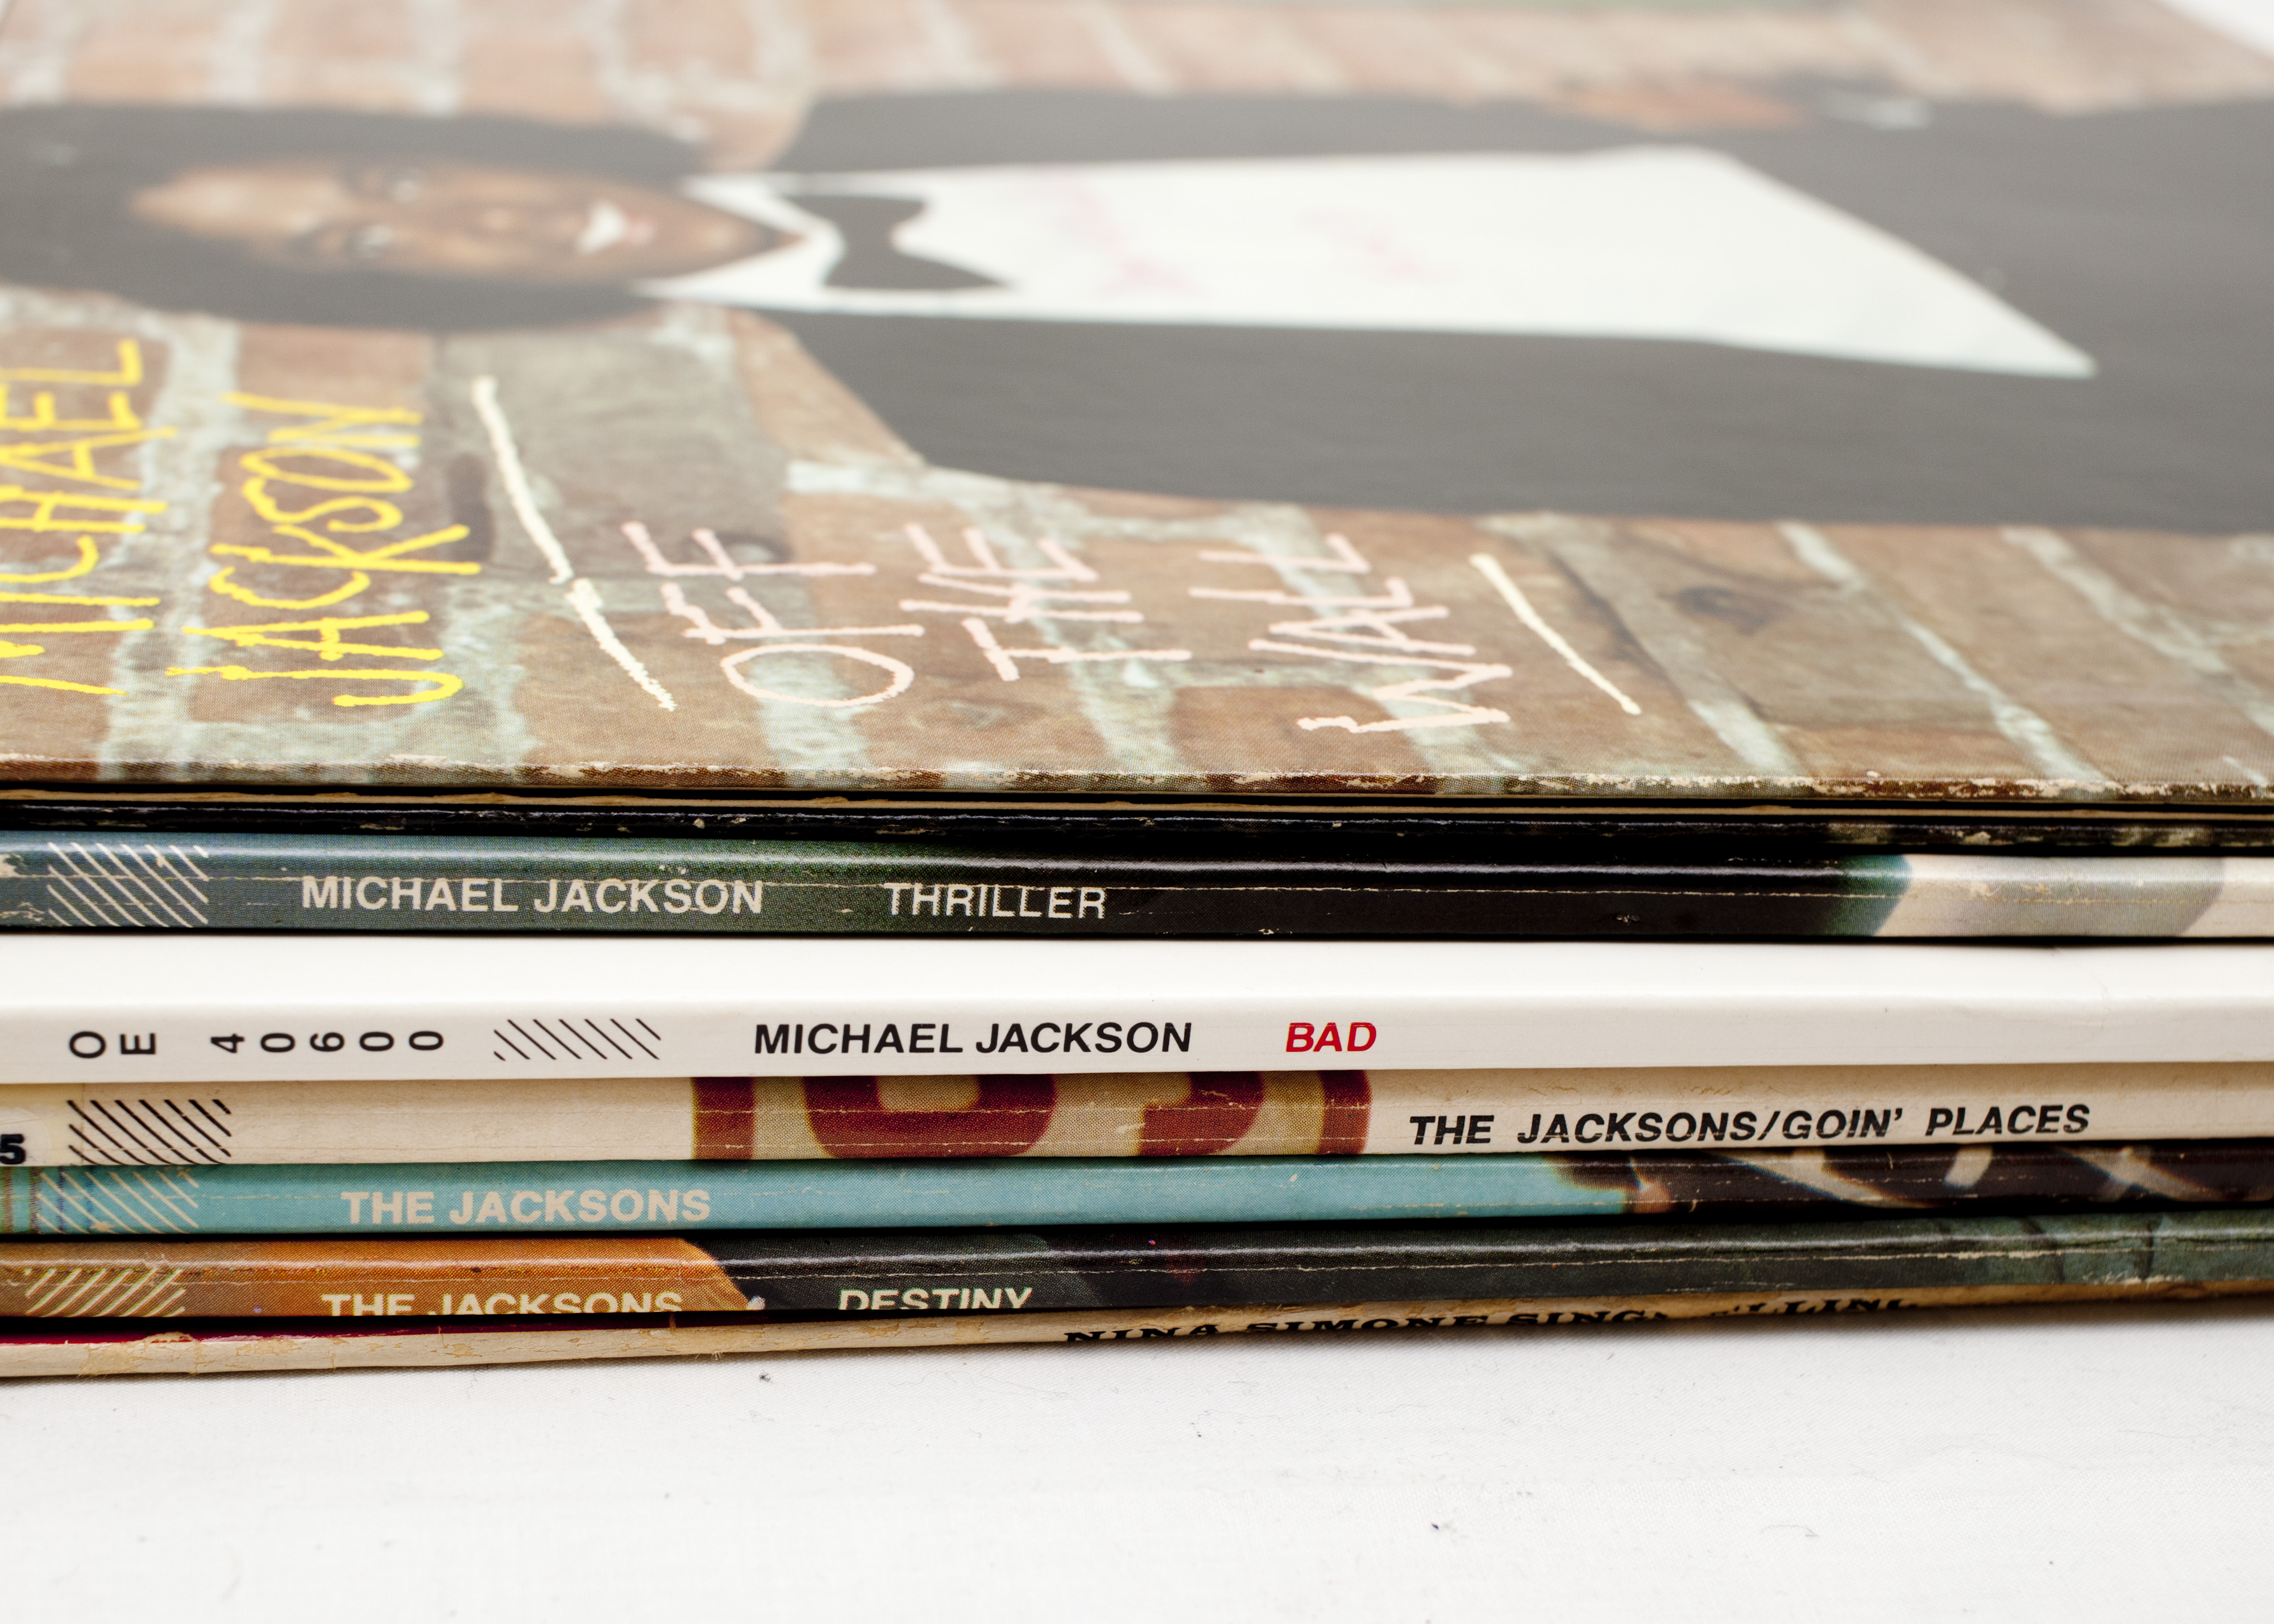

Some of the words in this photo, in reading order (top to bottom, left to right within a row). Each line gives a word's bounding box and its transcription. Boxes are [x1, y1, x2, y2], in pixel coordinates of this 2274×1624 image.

[165, 392, 482, 707] JACKSON
[621, 522, 924, 707] OFF
[899, 523, 1192, 681] THE
[1189, 533, 1513, 733] WALL
[302, 876, 518, 912] MICHAEL
[534, 879, 763, 913] JACKSON
[883, 882, 1106, 919] THRILLER
[210, 1031, 444, 1053] 40600
[754, 1023, 963, 1054] MICHAEL
[976, 1021, 1192, 1054] JACKSON
[1285, 1022, 1377, 1053] BAD
[1409, 1114, 1495, 1145] THE
[1517, 1108, 1903, 1144] JACKSONS/GOIN'
[1926, 1104, 2090, 1136] PLACES
[341, 1191, 434, 1224] THE
[449, 1189, 711, 1223] JACKSONS
[321, 1293, 415, 1316] THE
[428, 1291, 683, 1315] JACKSONS
[839, 1286, 1033, 1311] DESTINY
